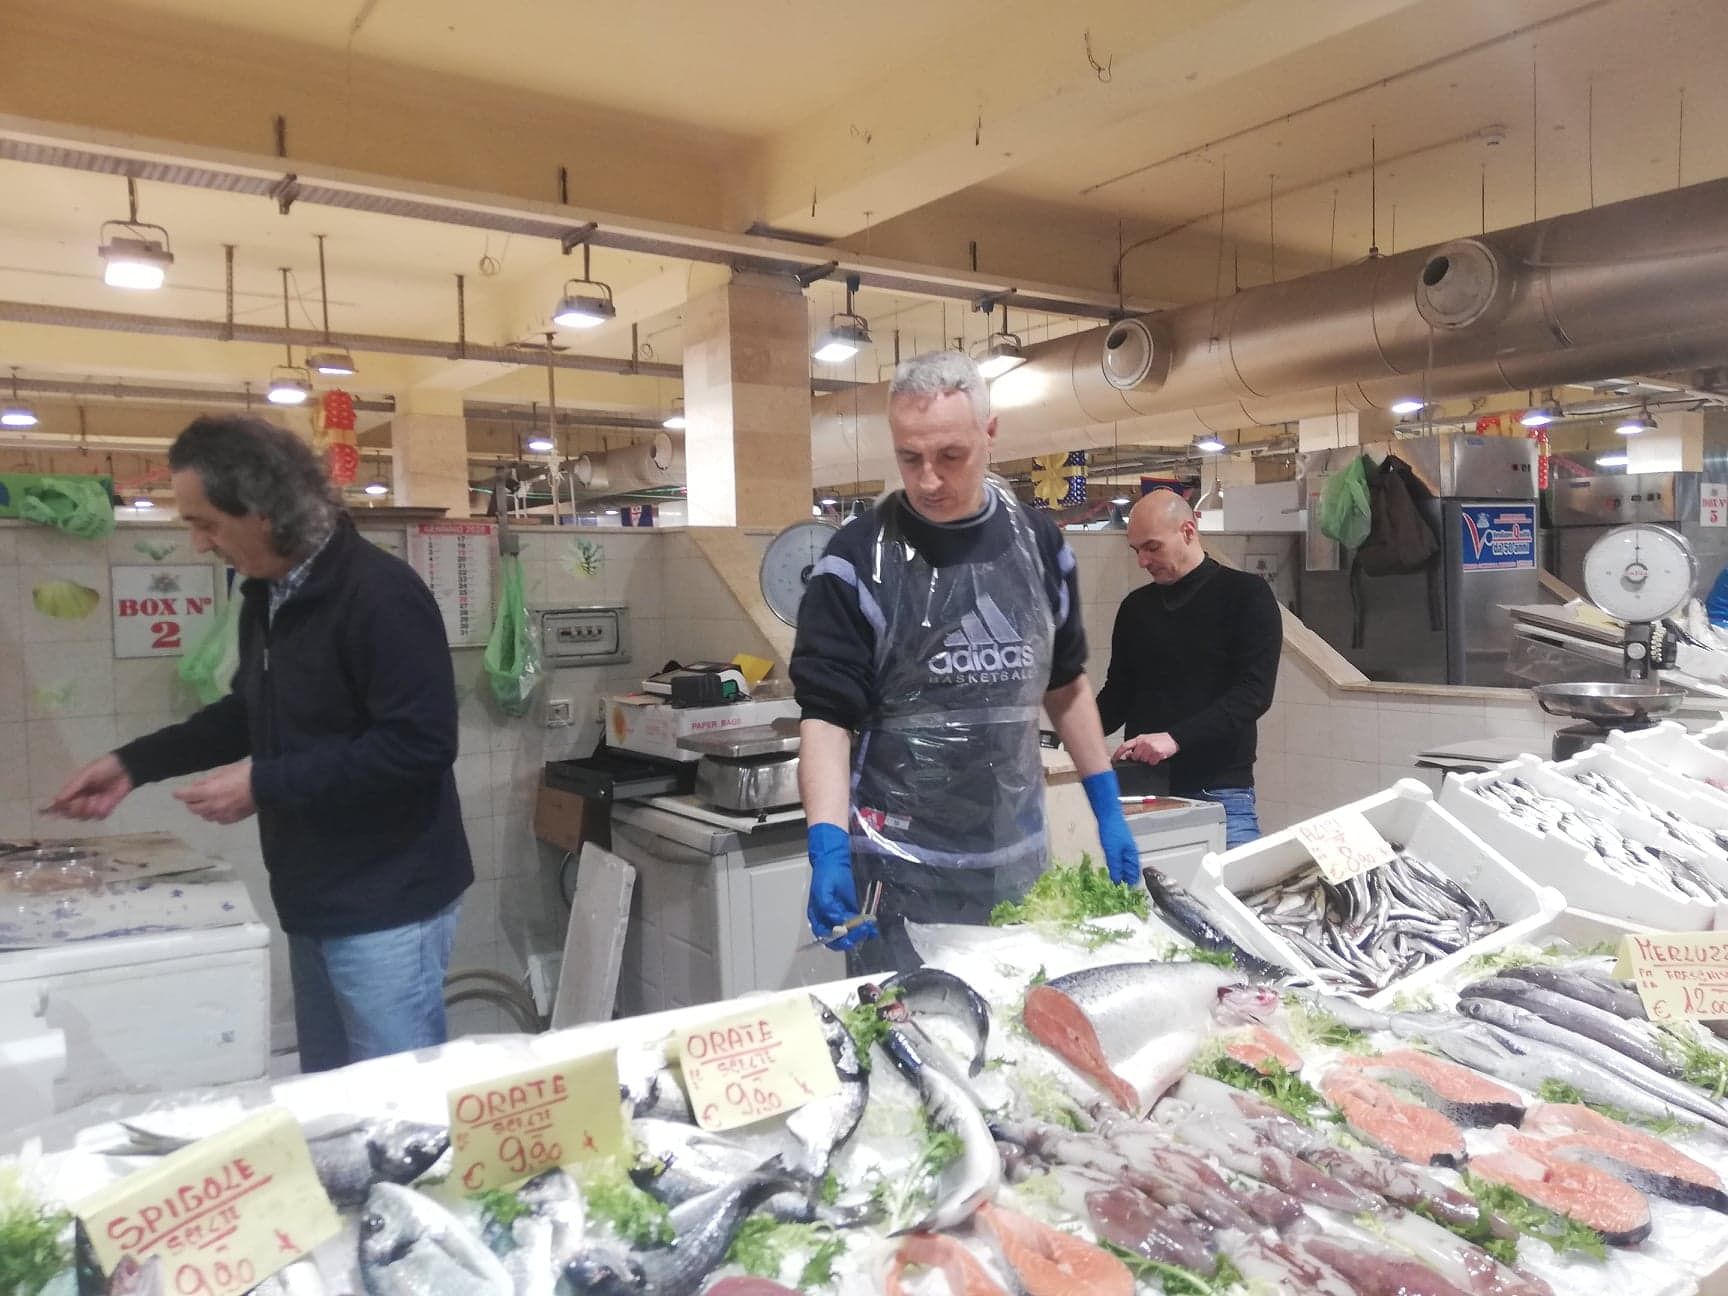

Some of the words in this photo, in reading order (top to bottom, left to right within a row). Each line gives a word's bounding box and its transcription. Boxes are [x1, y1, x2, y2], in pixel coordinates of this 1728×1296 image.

[1711, 510, 1719, 523] 5
[118, 598, 177, 617] BOX
[150, 621, 181, 649] 2
[928, 643, 1034, 674] adidas
[691, 720, 718, 730] PAPER
[686, 1019, 773, 1059] ORATE
[455, 1074, 567, 1124] ORATE
[107, 1157, 256, 1251] SPIGOLE
